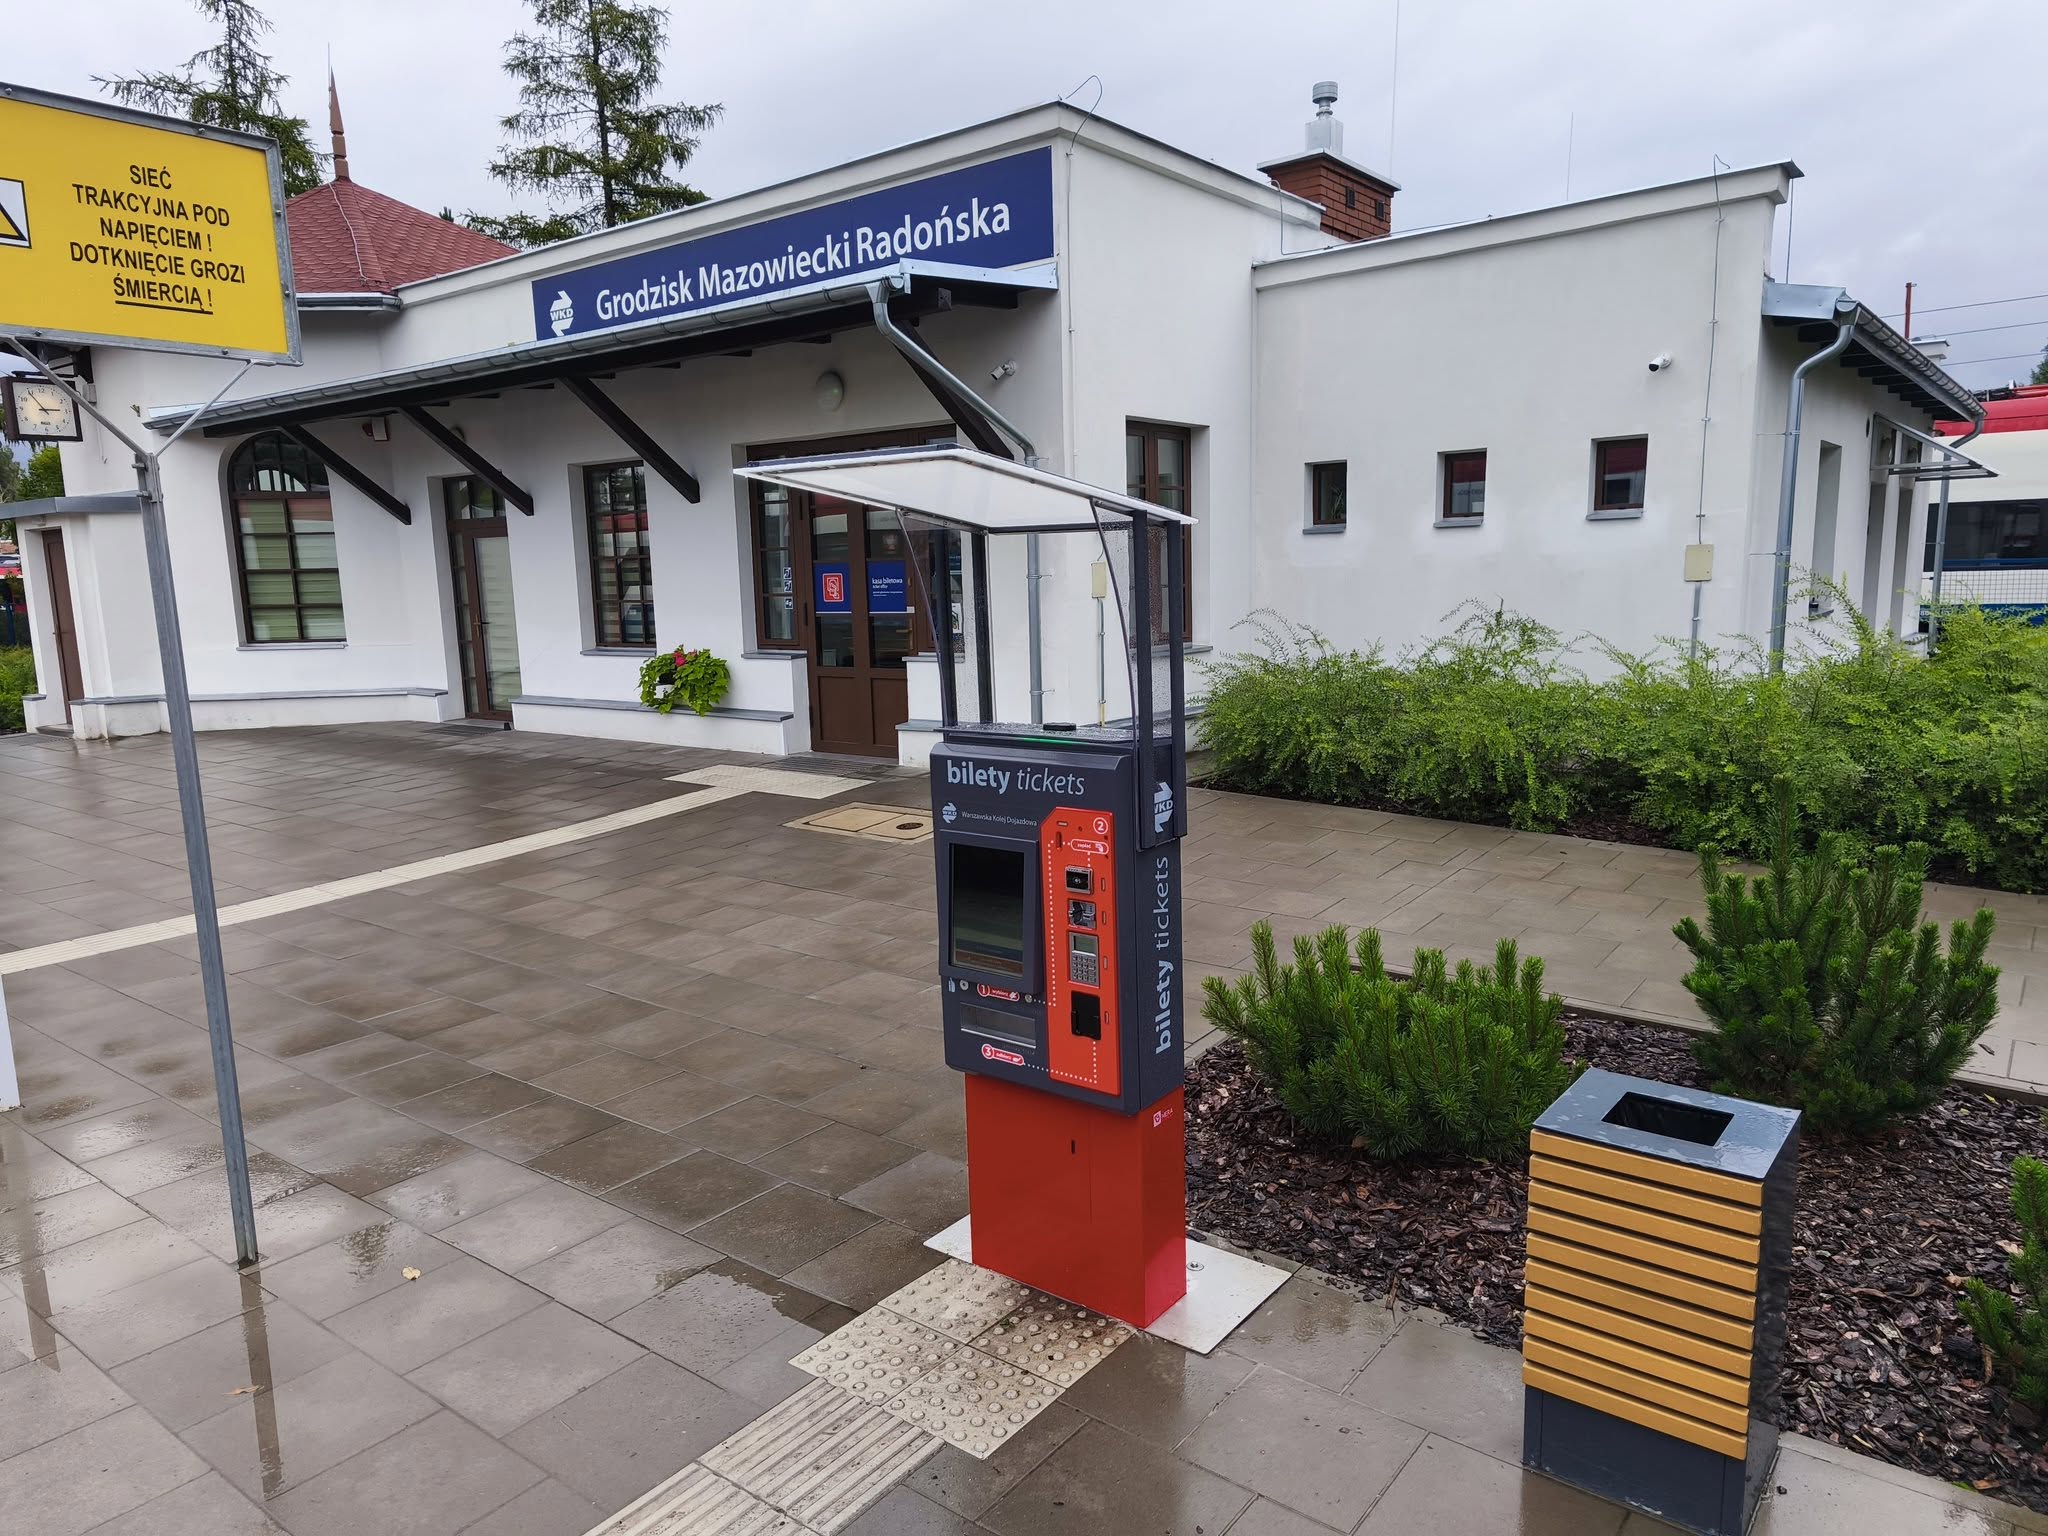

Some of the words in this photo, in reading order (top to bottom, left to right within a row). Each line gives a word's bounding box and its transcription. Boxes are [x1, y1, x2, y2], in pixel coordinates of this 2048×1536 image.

[129, 165, 172, 190] SIEĆ
[72, 183, 189, 220] TRAKCYJNA
[192, 203, 230, 227] POD
[100, 217, 202, 250] NAPIĘCIEM
[69, 241, 186, 276] DOTKNIĘCIE
[190, 258, 245, 284] GROZI
[596, 270, 694, 320] Grodzisk
[699, 231, 850, 299] Mazowiecki
[856, 197, 1010, 265] Radońska
[113, 273, 204, 311] ŚMIERCIĄ
[550, 308, 574, 321] WKD
[946, 759, 1011, 795] bilety
[1017, 767, 1085, 795] tickets
[961, 811, 992, 821] Warszawska
[992, 815, 1007, 824] Kolej
[1007, 816, 1038, 826] Dojazdowa
[1097, 821, 1104, 831] 2
[1153, 856, 1170, 951] tickets
[982, 985, 986, 994] 1
[1155, 960, 1174, 1055] bilety
[985, 1047, 991, 1057] 3
